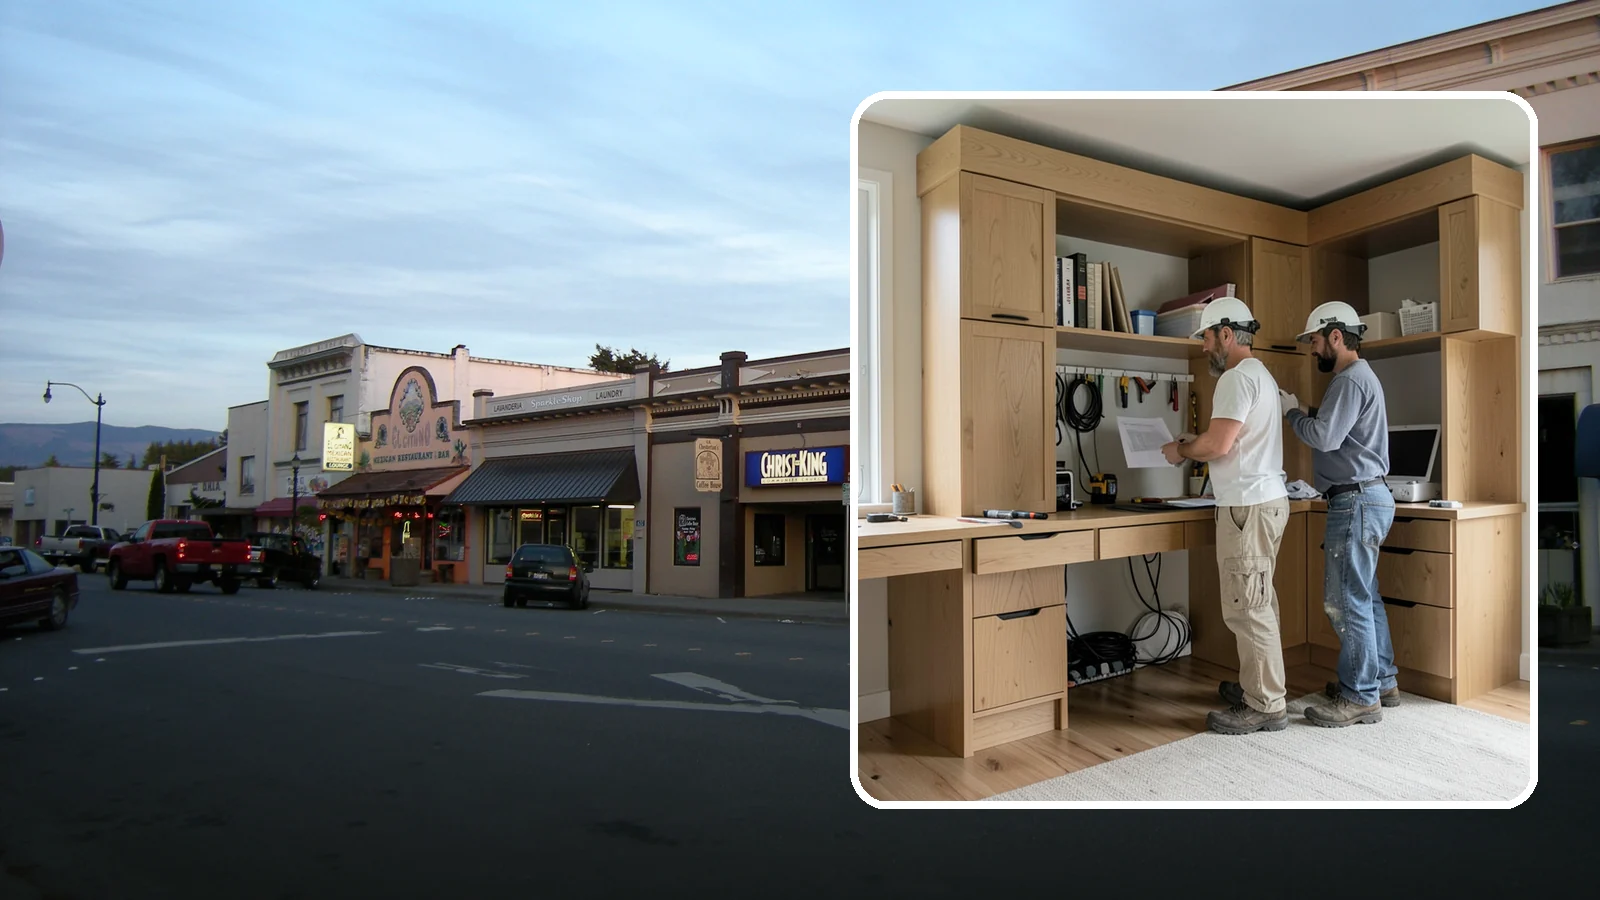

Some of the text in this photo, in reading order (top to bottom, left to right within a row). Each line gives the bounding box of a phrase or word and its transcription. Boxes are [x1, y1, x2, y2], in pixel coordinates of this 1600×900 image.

[493, 388, 624, 412] LAVANDERIA Sparkle Shop LAUNDRY
[373, 455, 396, 464] MEXICAN
[397, 451, 433, 462] RESTAURANT
[438, 450, 450, 458] BAR
[760, 450, 828, 478] CHRIST KING
